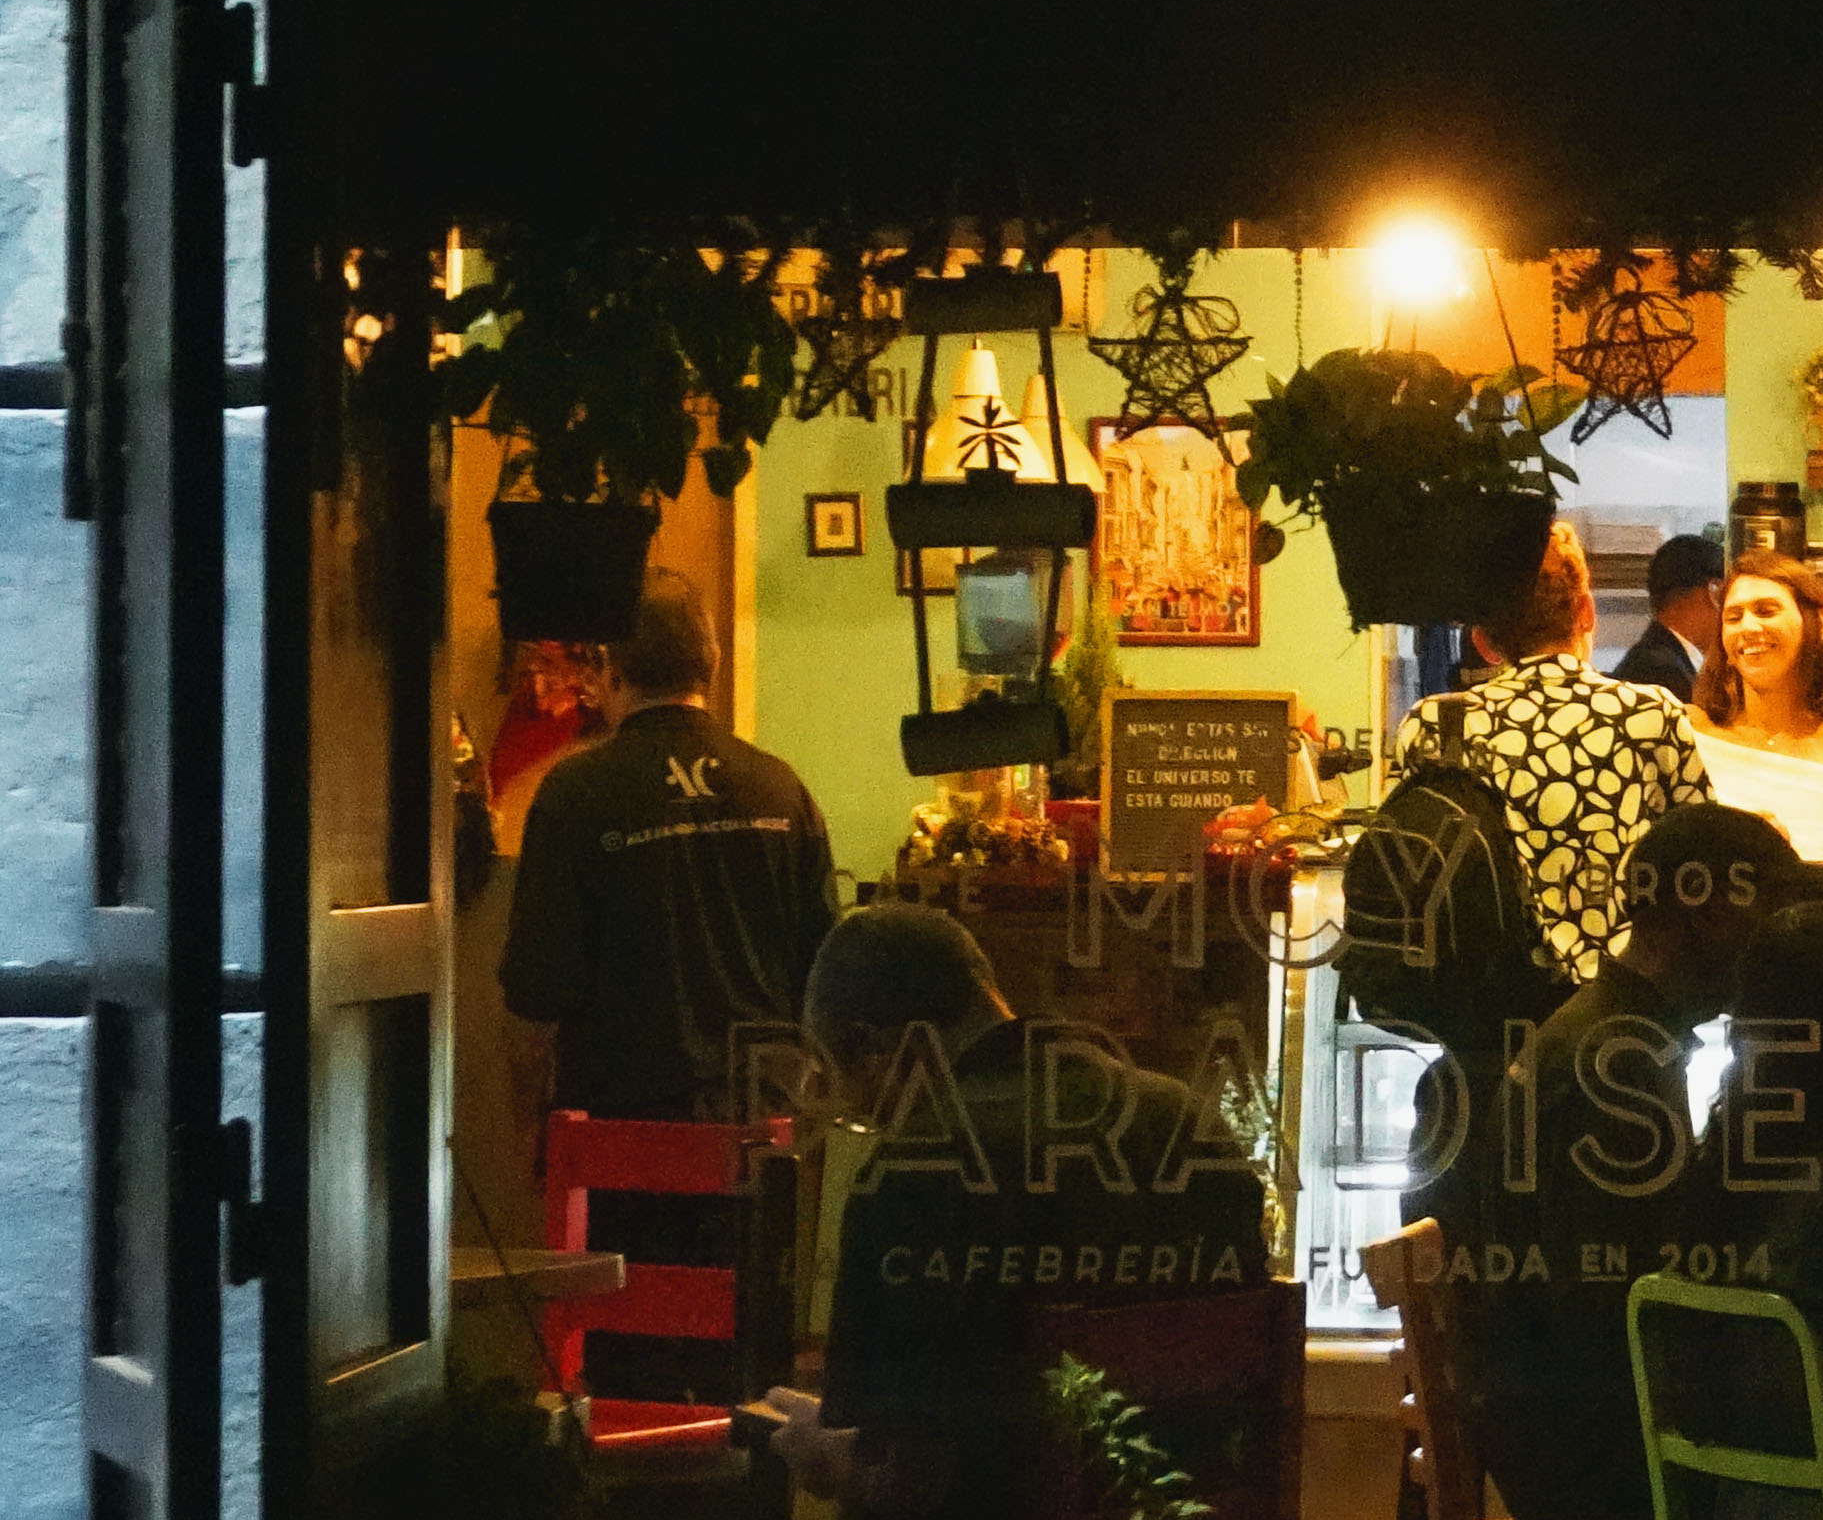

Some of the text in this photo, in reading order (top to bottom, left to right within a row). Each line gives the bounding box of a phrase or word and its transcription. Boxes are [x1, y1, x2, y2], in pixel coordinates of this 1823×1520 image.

[1126, 770, 1257, 785] EL UNIVERSO TE
[1125, 793, 1233, 809] ESTA GUIANDO
[727, 1012, 1823, 1198] PARADISE
[879, 1233, 1243, 1287] CAFEBRERÍA
[1580, 1242, 1631, 1274] EN
[1658, 1242, 1773, 1282] 2014
